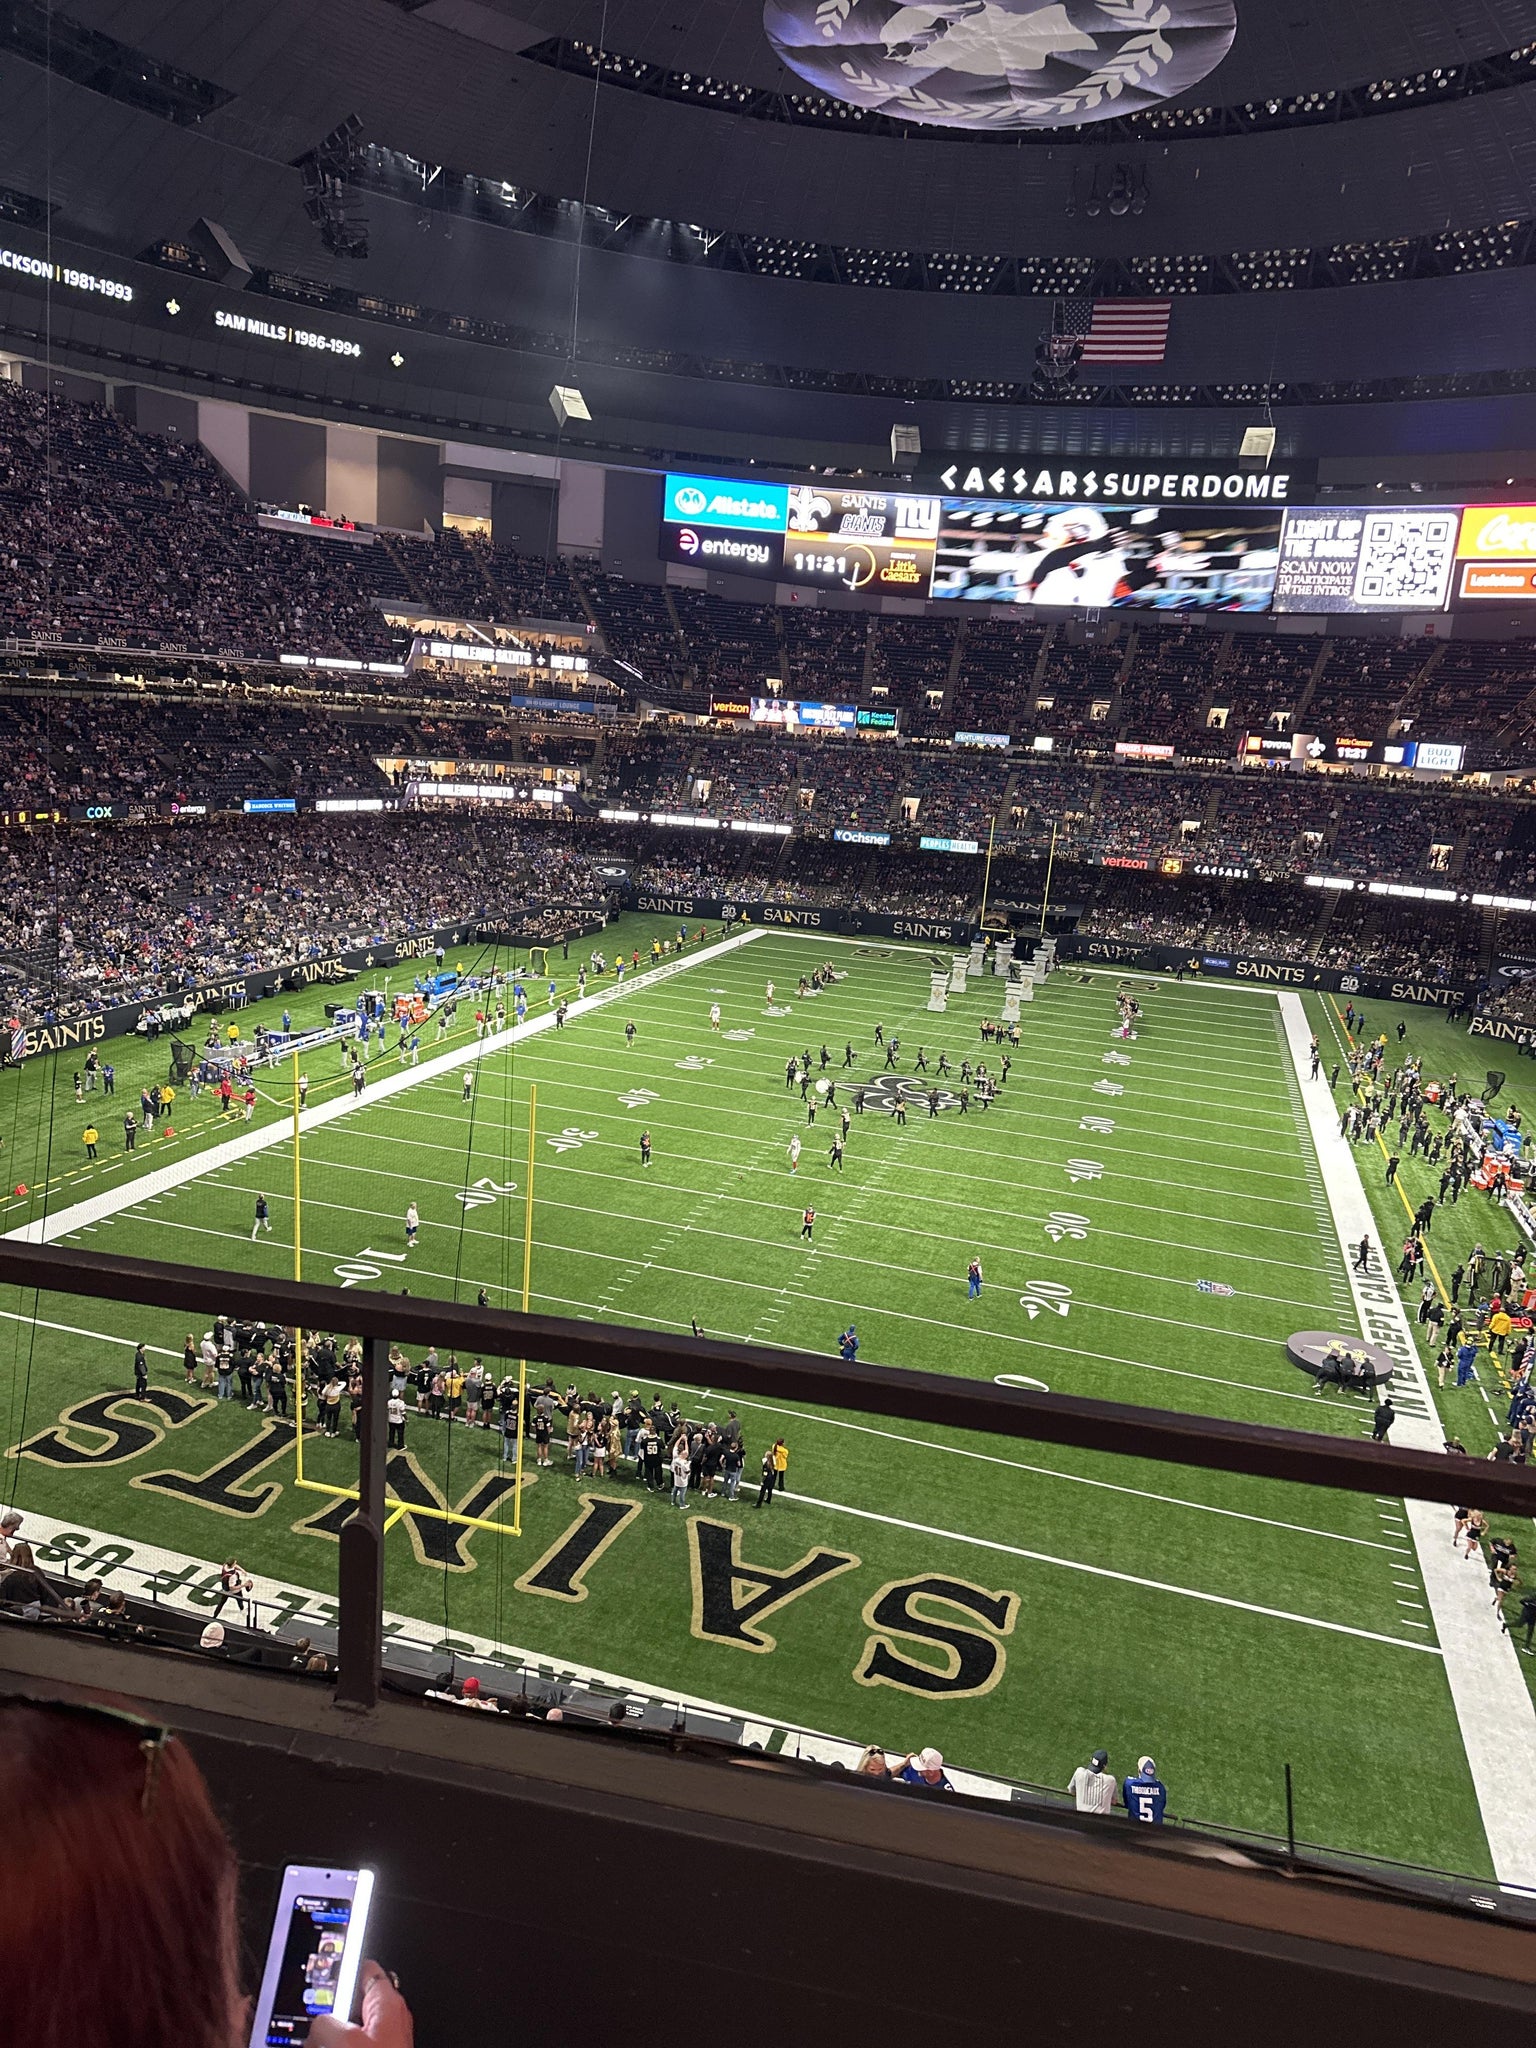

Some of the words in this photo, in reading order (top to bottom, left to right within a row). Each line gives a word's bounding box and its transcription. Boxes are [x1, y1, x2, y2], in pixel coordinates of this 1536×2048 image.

[0, 248, 53, 279] CKSON
[63, 268, 133, 301] 1981-1993
[215, 311, 245, 331] SAM
[247, 319, 287, 341] MILLS
[294, 330, 361, 357] 1986-1994
[941, 465, 1098, 497] CAESARS
[1103, 473, 1290, 498] SUPERDOME
[706, 495, 778, 519] Allstate
[841, 494, 887, 510] SAINTS
[841, 514, 886, 533] GIANTS
[701, 539, 770, 563] entergy
[794, 553, 846, 573] 11:21
[889, 560, 917, 573] Little
[1280, 561, 1319, 574] SCAN
[1320, 562, 1356, 575] NOW
[880, 569, 921, 583] Caesars
[1278, 575, 1293, 584] TO
[1293, 575, 1353, 585] PARTICIPATE
[1278, 585, 1291, 594] IN
[1292, 585, 1312, 595] THE
[1313, 586, 1351, 596] INTROS
[31, 630, 62, 642] SAINTS
[98, 637, 127, 647] SAINTS
[160, 642, 187, 653] SAINTS
[219, 648, 244, 658] SAINTS
[6, 659, 35, 668] SAINTS
[68, 663, 97, 672] SAINTS
[398, 687, 423, 695] SAINTS
[454, 691, 480, 700] SAINTS
[713, 702, 749, 713] verizon
[871, 712, 896, 720] Keesler
[871, 718, 894, 726] Federal
[924, 729, 949, 737] SAINTS
[956, 734, 984, 742] VENTURE
[985, 736, 1009, 744] GLOBAL
[1080, 740, 1107, 748] SAINTS
[1262, 741, 1291, 749] TOYOTA
[1202, 749, 1229, 757] SAINTS
[1427, 747, 1452, 757] BUD
[1420, 757, 1455, 767] LIGHT
[86, 806, 112, 819] COX
[129, 804, 157, 814] SAINTS
[180, 804, 206, 815] entergy
[804, 826, 830, 836] SAINTS
[842, 831, 890, 846] Ochsner
[921, 838, 950, 850] PEOPLES
[952, 841, 977, 853] HEALTH
[1102, 856, 1148, 870] verizon
[1194, 864, 1249, 880] CAESARS
[1259, 869, 1291, 880] SAINTS
[638, 897, 694, 914] SAINTS
[994, 899, 1067, 913] SAINTS
[763, 908, 821, 927] SAINTS
[893, 921, 952, 940] SAINTS
[395, 935, 435, 958] SAINTS
[1236, 961, 1305, 983] SAINTS
[1391, 983, 1465, 1005] SAINTS
[25, 1015, 105, 1055] SAINTS
[1078, 1116, 1116, 1135] 50
[546, 1126, 599, 1149] 30
[1064, 1158, 1105, 1180] 40
[454, 1177, 518, 1206] 20
[1044, 1211, 1092, 1241] 30
[332, 1246, 408, 1282] 10
[1019, 1280, 1074, 1318] 20
[647, 1445, 658, 1455] 50
[4, 1385, 1022, 1701] SAINTS
[36, 1532, 134, 1577] US
[1139, 1797, 1154, 1823] 5
